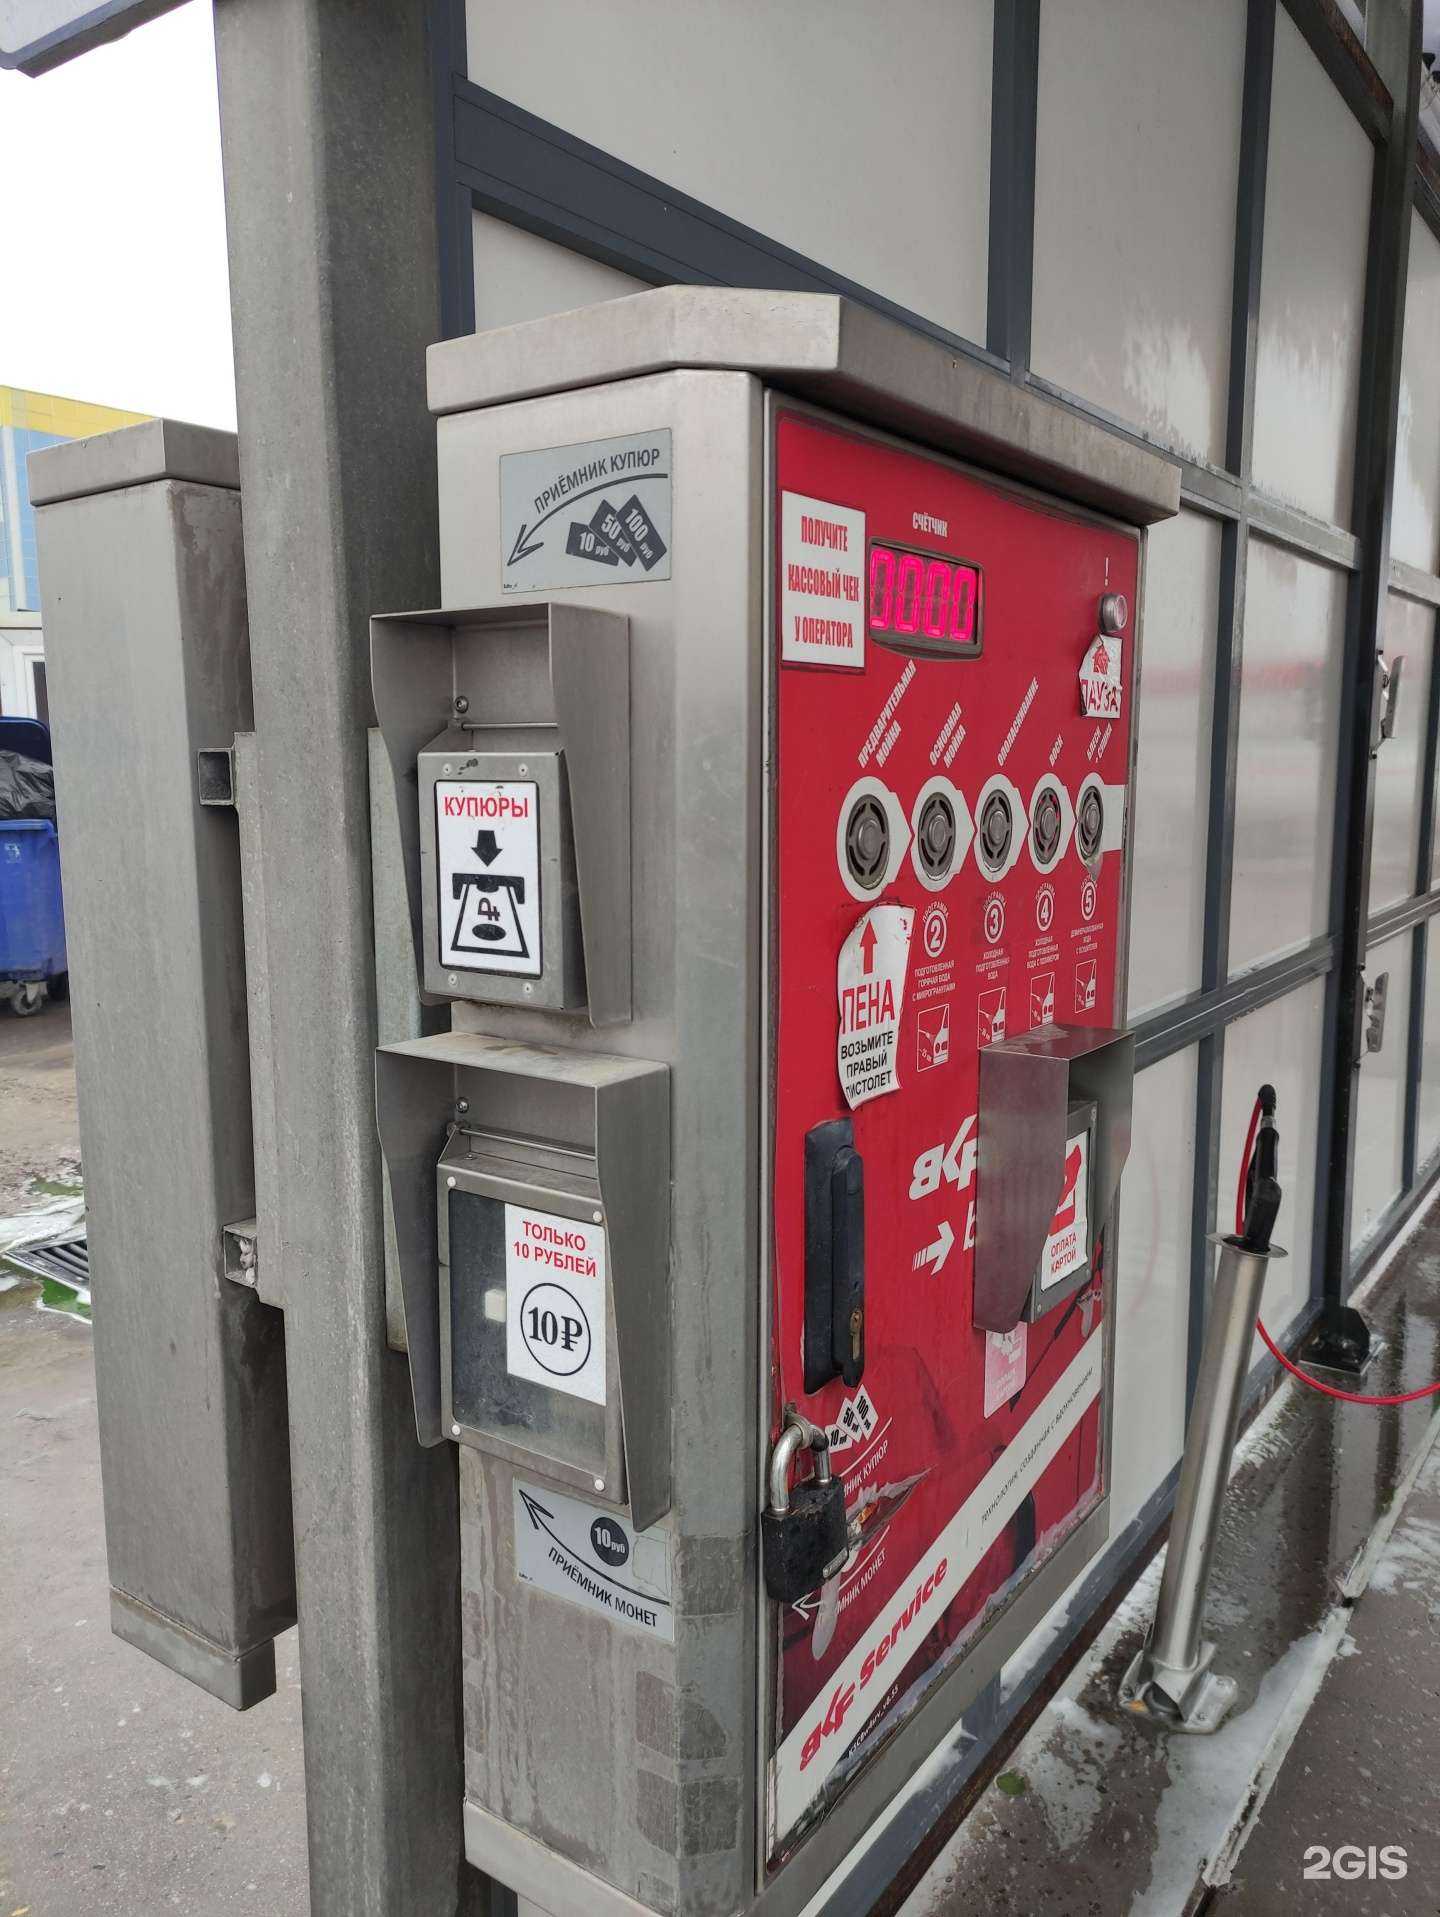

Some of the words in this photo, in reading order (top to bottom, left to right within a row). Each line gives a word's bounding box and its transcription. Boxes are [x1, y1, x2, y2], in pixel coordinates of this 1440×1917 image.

[533, 457, 608, 514] ПРИЁМНИК
[610, 448, 660, 473] КУПЮР
[601, 513, 623, 540] 50
[624, 508, 648, 541] 100
[801, 515, 848, 552] ПОЛУЧИТЕ
[912, 511, 948, 538] СЧЁТЧИК
[580, 531, 595, 551] 10
[788, 563, 841, 599] КАССОВЫЙ
[843, 573, 859, 602] ЧЕК
[795, 616, 801, 642] У
[802, 616, 853, 648] ОПЕРАТОРА
[857, 659, 917, 768] ПРЕДВАРИТЕЛЬНАЯ
[997, 676, 1039, 767] ОПОЛАСКИВАНИЕ
[875, 719, 902, 768] МОЙКА
[929, 701, 962, 766] ОСНОВНАЯ
[943, 724, 967, 768] МОЙКА
[1049, 734, 1064, 767] ВОСК
[443, 796, 529, 818] КУПЮРЫ
[1040, 898, 1049, 923] 4
[1084, 889, 1093, 914] 5
[929, 919, 941, 949] 2
[989, 908, 999, 935] 3
[842, 979, 896, 1035] ПЕНА
[841, 1030, 894, 1059] ВОЗЬМИТЕ
[846, 1049, 888, 1078] ПРАВЫЙ
[522, 1220, 586, 1251] ТОЛЬКО
[1051, 1232, 1077, 1257] ОПЛАТА
[513, 1241, 530, 1259] 10
[534, 1246, 597, 1278] РУБЛЕЙ
[1051, 1246, 1077, 1273] КАРТОЙ
[863, 1439, 889, 1476] КУПЮР
[594, 1526, 612, 1549] 10
[548, 1546, 613, 1607] ПРИЁМНИК
[615, 1597, 658, 1627] МОНЕТ
[860, 1548, 886, 1595] МОНЕТ
